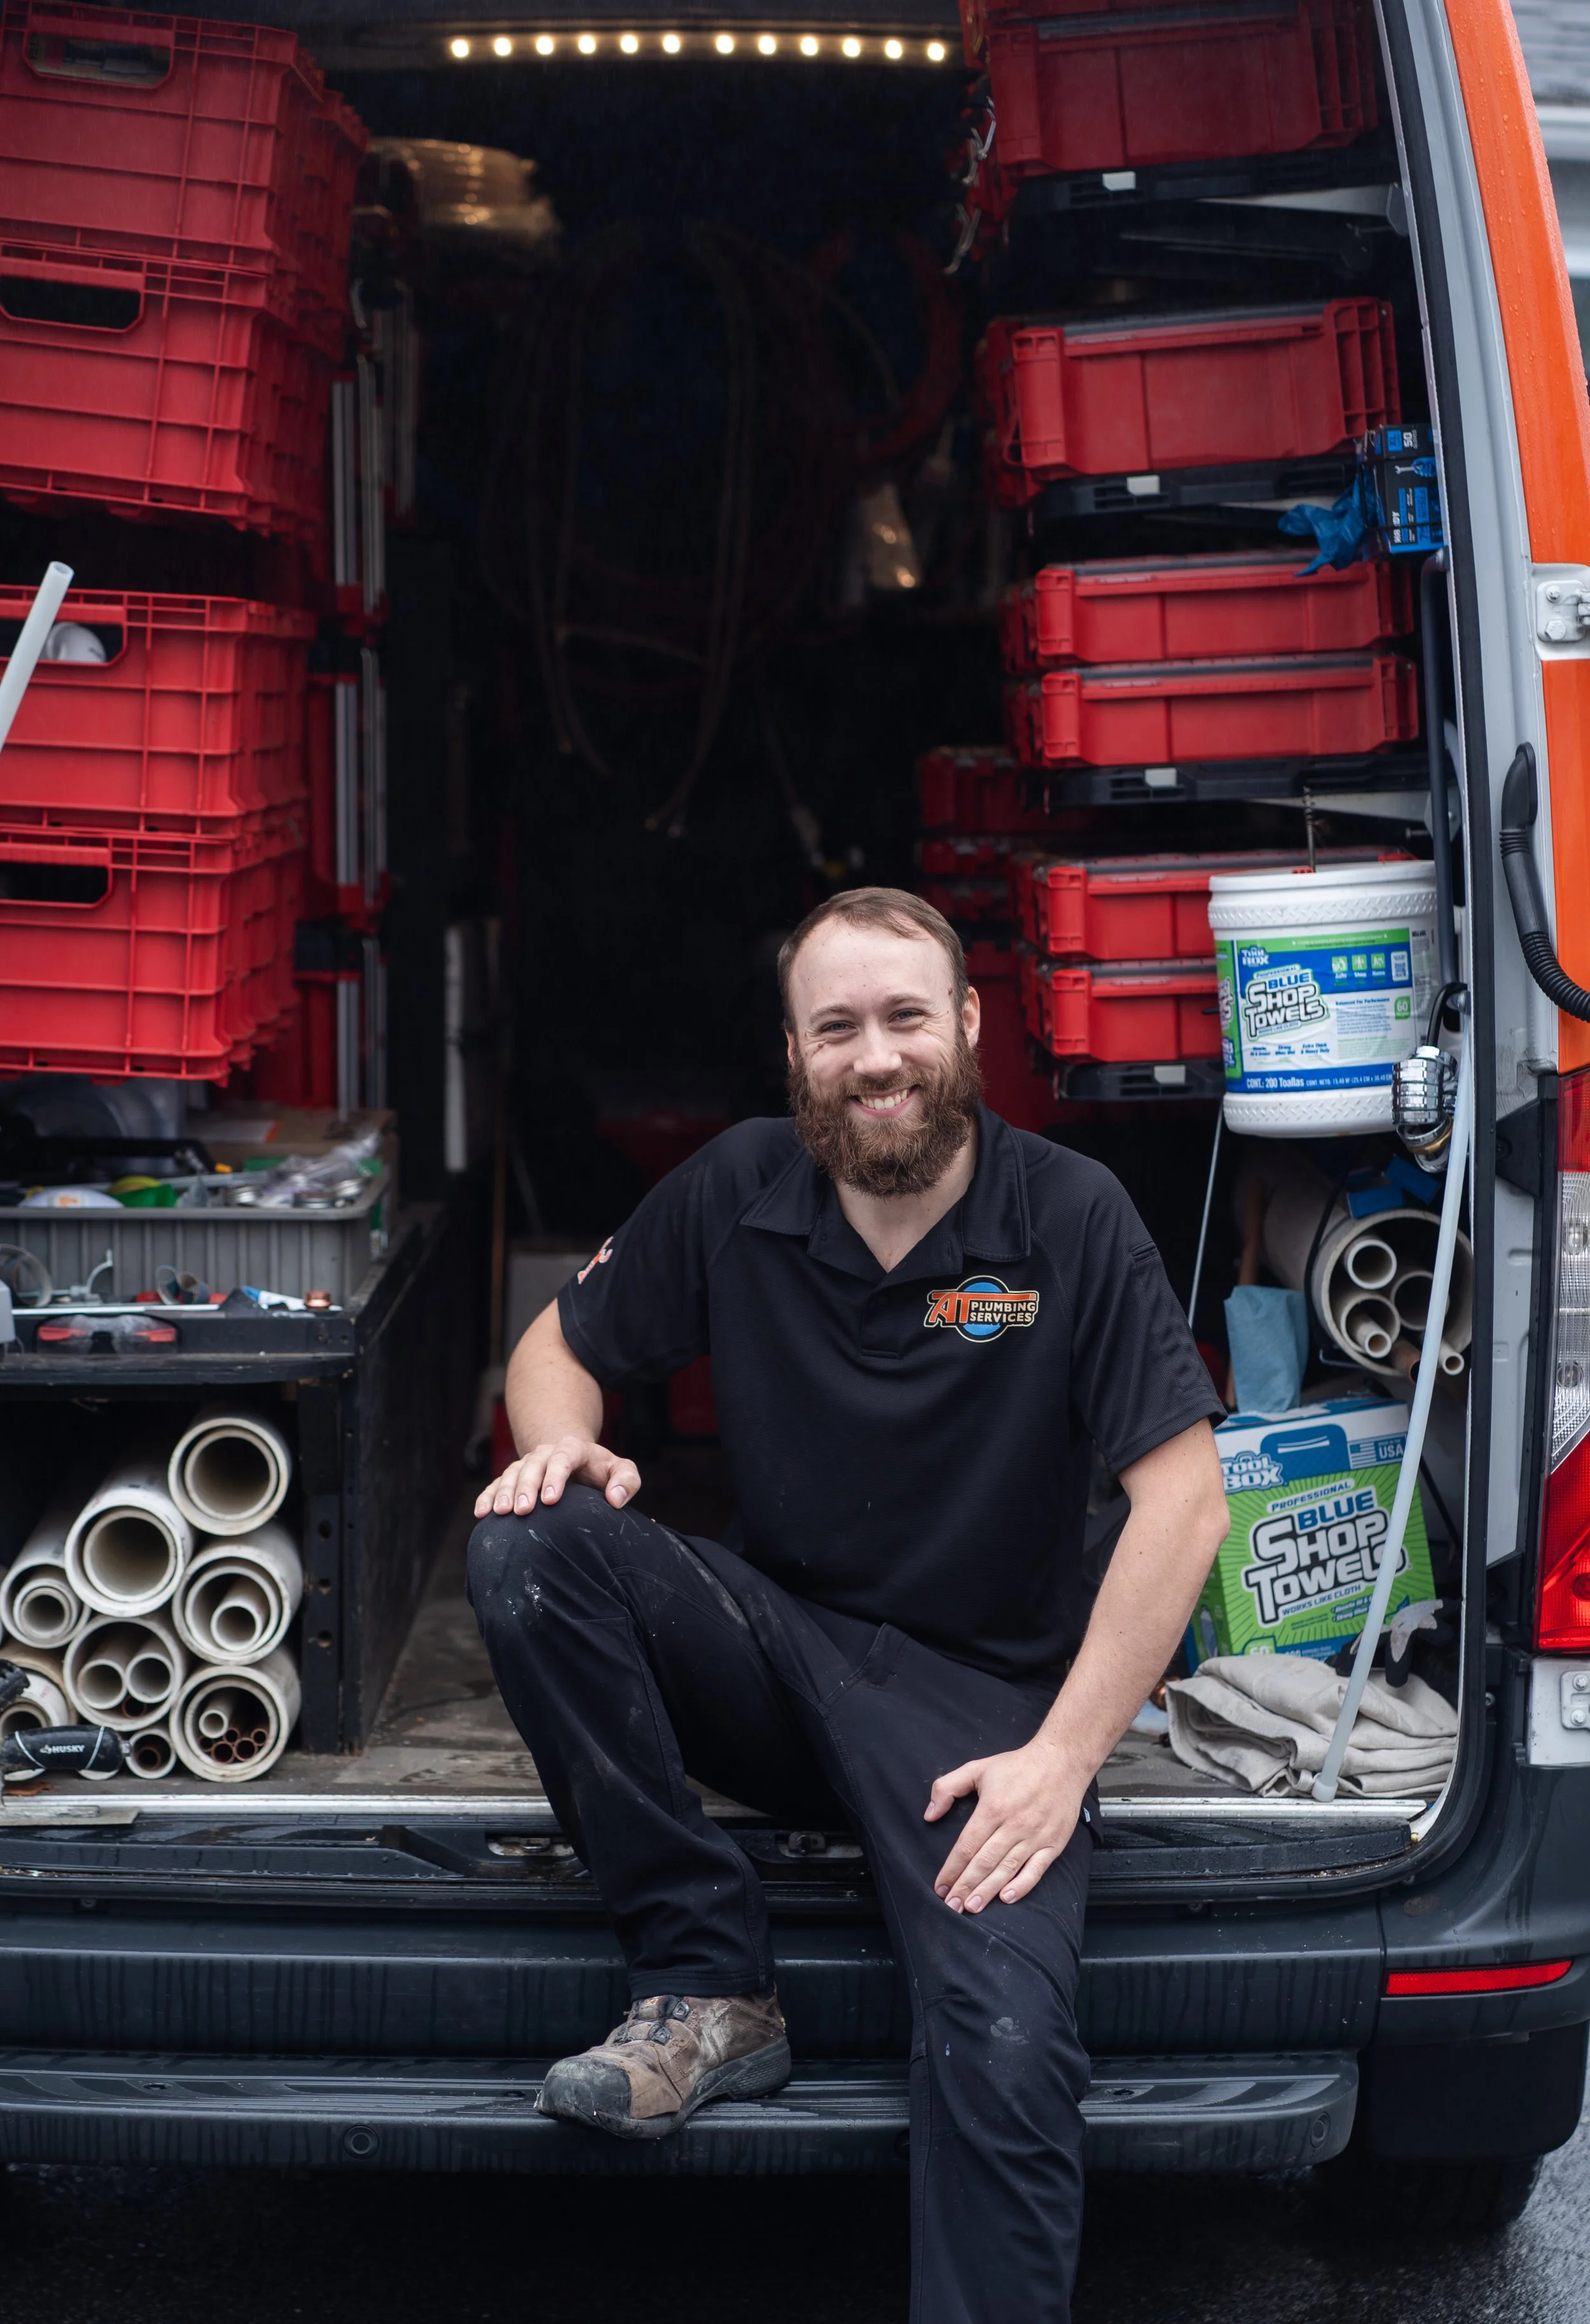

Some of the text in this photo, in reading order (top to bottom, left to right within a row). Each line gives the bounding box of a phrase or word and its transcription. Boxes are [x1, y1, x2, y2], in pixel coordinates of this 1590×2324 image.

[1403, 431, 1413, 448] 50
[1242, 956, 1269, 966] BOX
[1268, 972, 1310, 990] BLUE
[1249, 982, 1316, 1013] SHOP
[1397, 1001, 1408, 1012] 60
[1265, 1077, 1278, 1089] 200
[1279, 1076, 1304, 1087] Toallas
[971, 1302, 1036, 1312] PLUMBING
[970, 1312, 1032, 1323] SERVICES
[1378, 1444, 1404, 1459] USA
[1221, 1457, 1272, 1475] TOOL
[1224, 1468, 1282, 1491] BOX
[1272, 1482, 1352, 1512] PROFESSIONAL
[1297, 1491, 1374, 1530] BLUE
[1254, 1510, 1389, 1576] SHOP
[1282, 1584, 1362, 1616] WORKS LIKE CLOTH
[52, 1744, 85, 1754] HUSKY
